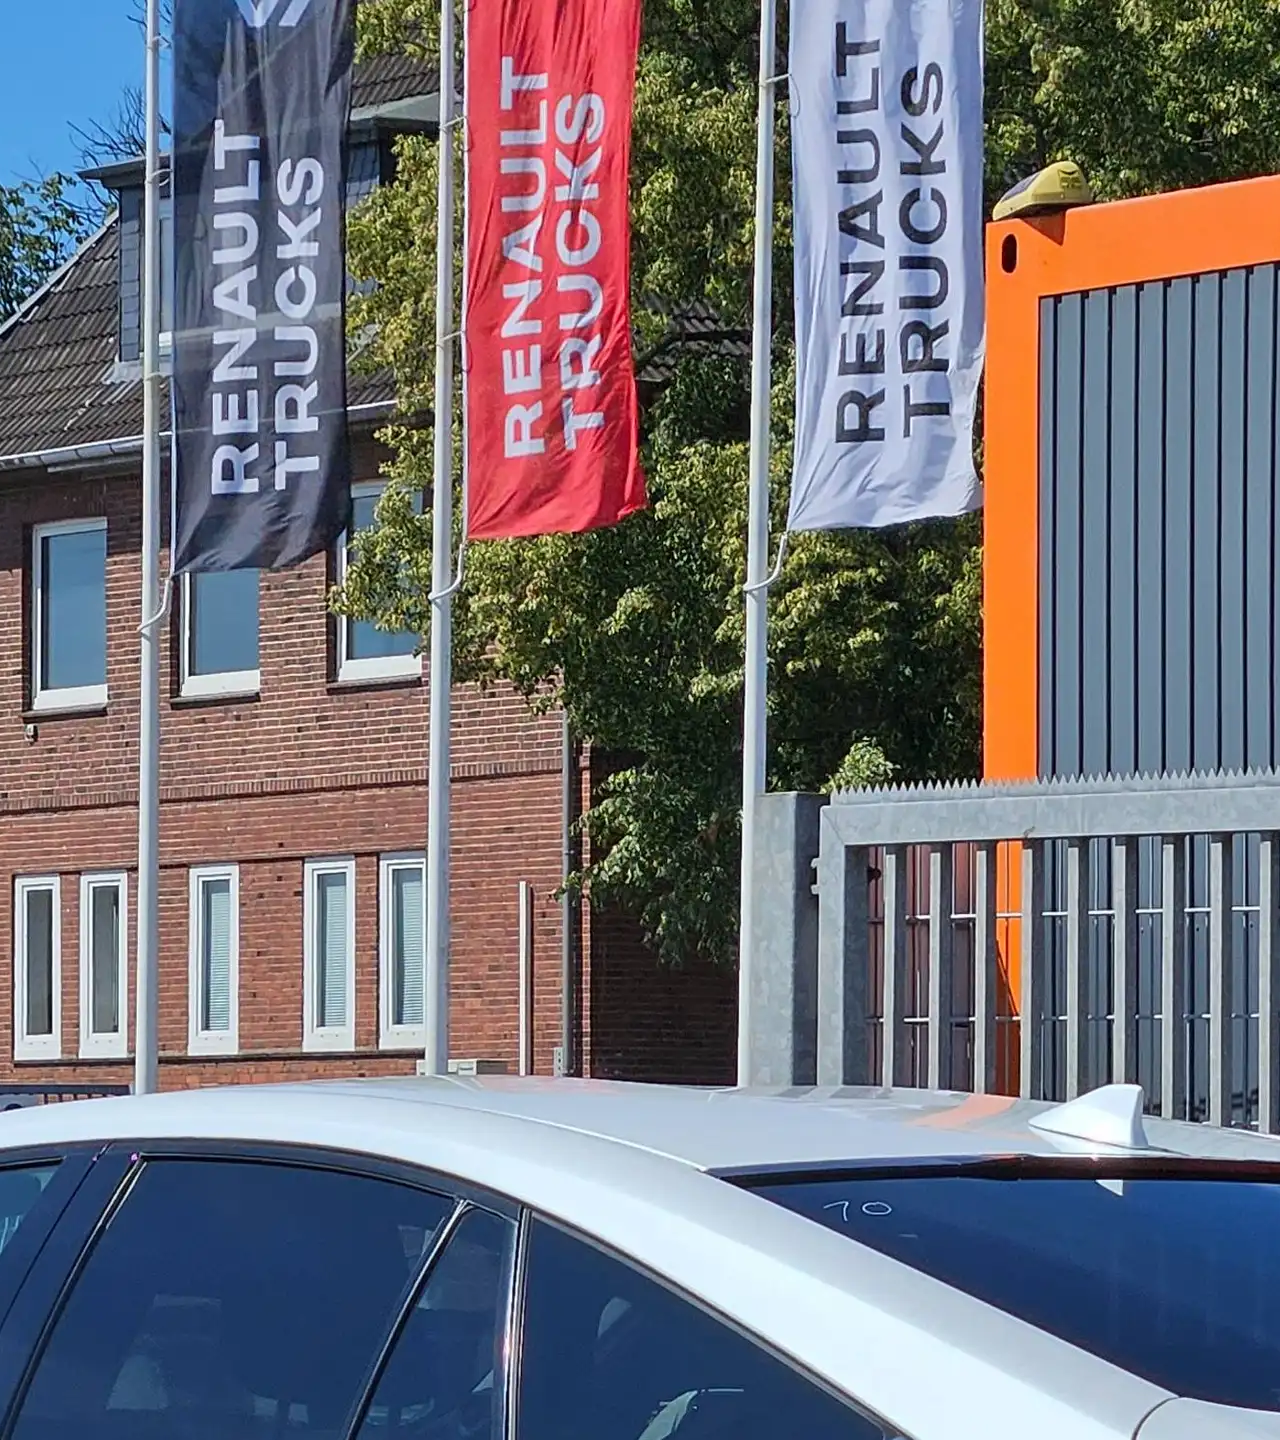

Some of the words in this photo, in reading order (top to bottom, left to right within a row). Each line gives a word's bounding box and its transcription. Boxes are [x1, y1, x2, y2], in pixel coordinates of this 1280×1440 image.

[212, 118, 261, 496] RENAULT
[274, 157, 324, 491] TRUCKS
[500, 56, 549, 458] RENAULT
[555, 91, 606, 451] TRUCKS
[835, 20, 885, 444] RENAULT
[899, 60, 948, 438] TRUCKS
